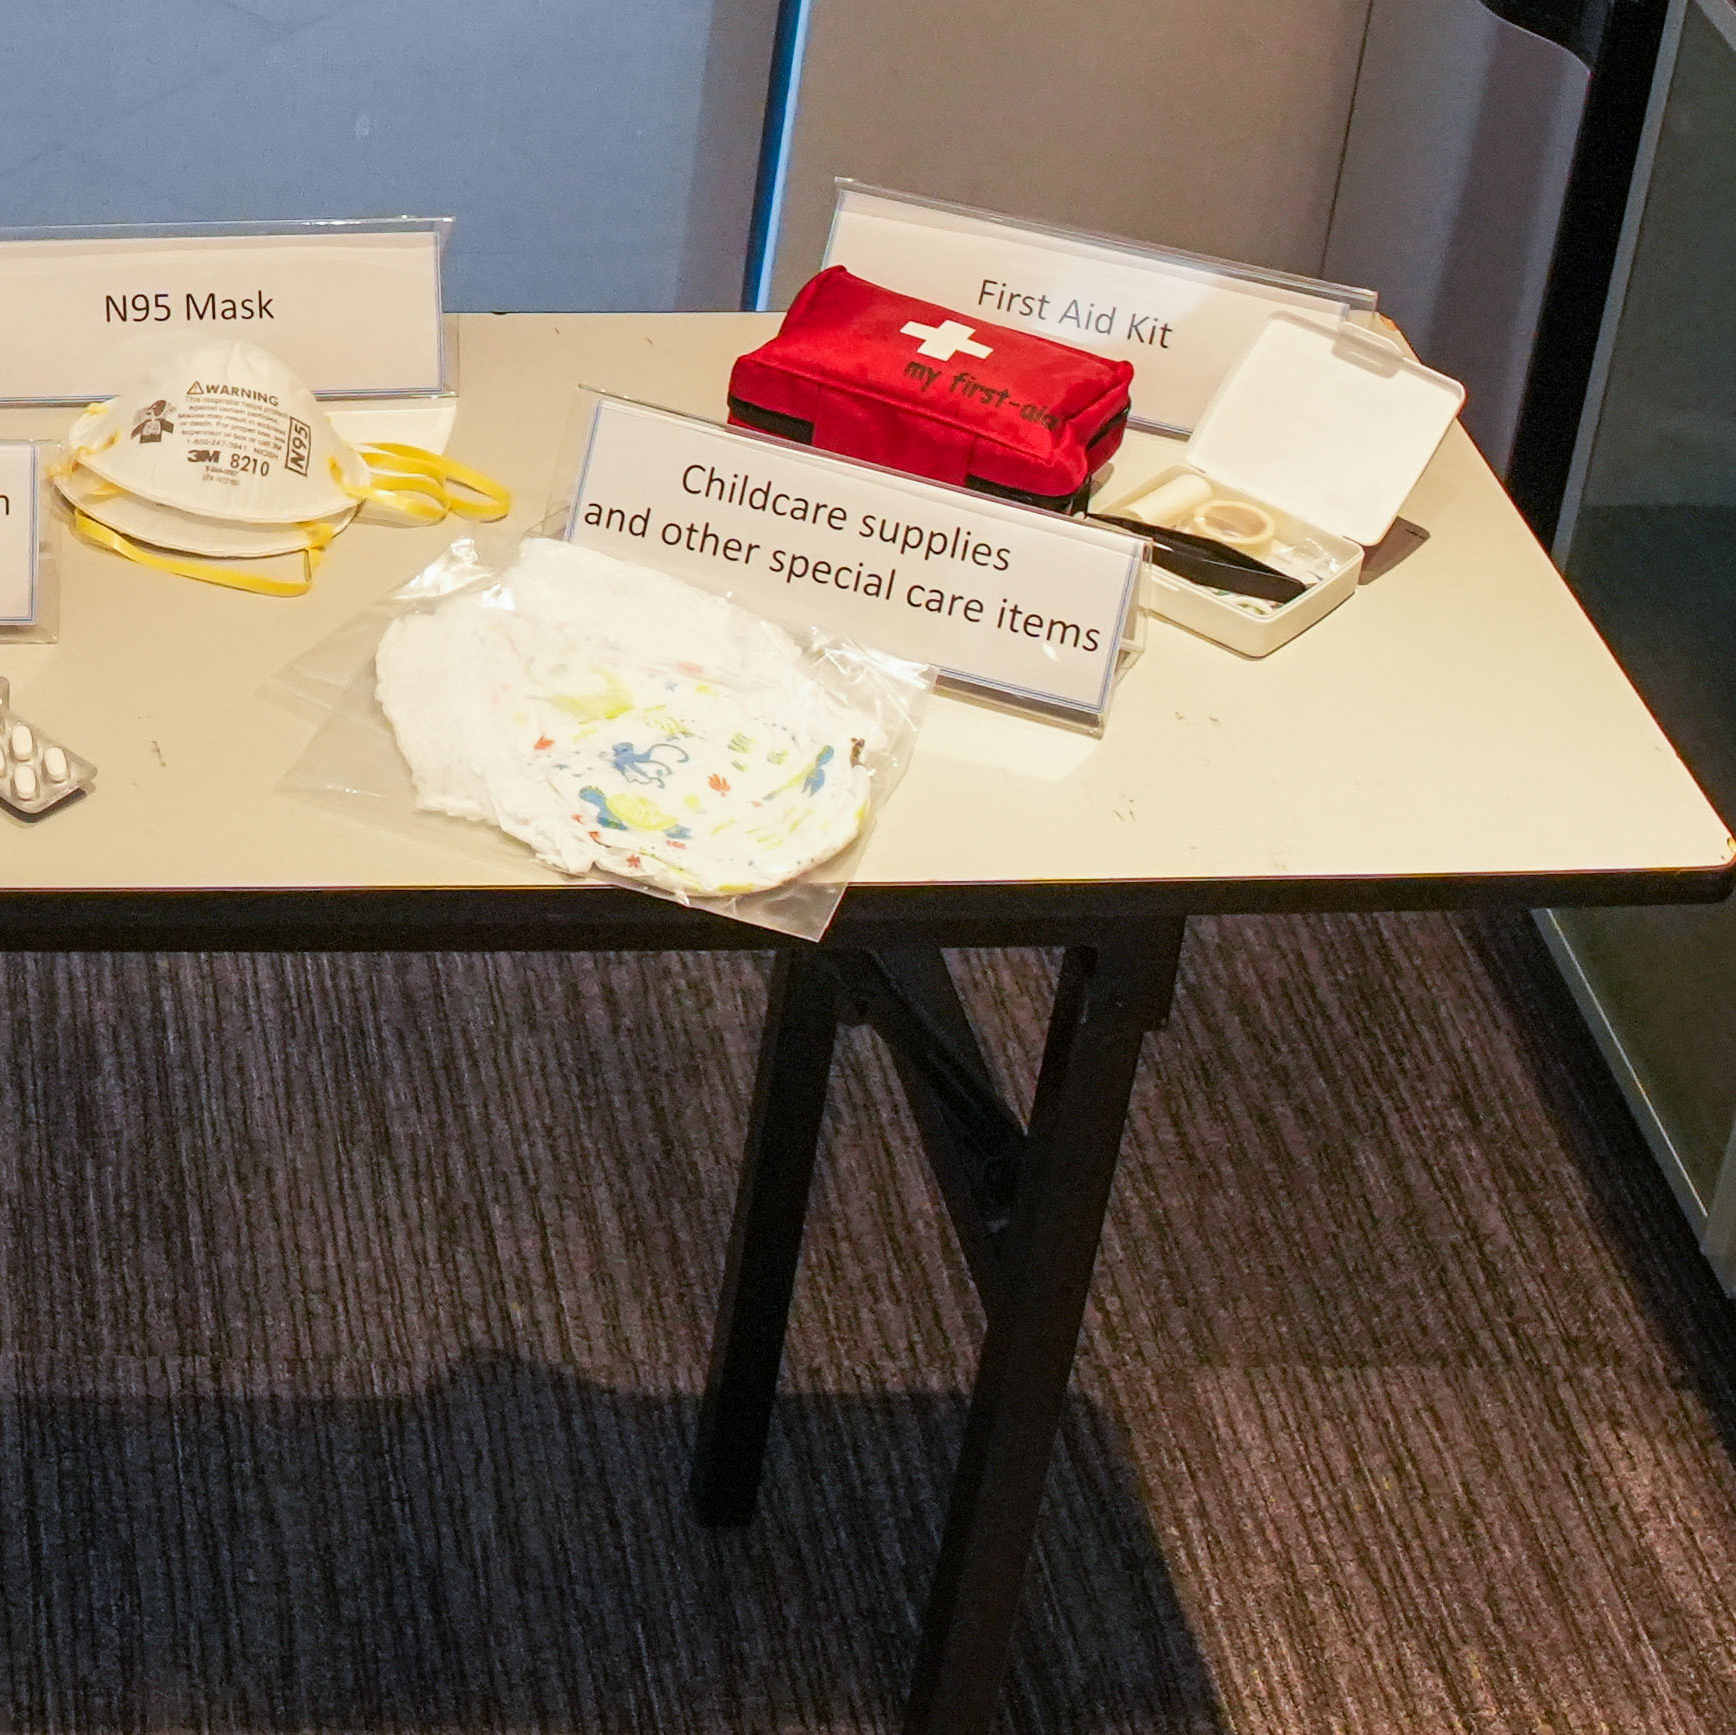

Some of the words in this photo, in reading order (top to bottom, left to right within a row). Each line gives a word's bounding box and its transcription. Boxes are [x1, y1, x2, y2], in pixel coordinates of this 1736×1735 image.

[105, 293, 171, 323] N95
[185, 289, 274, 321] Mask
[977, 279, 1050, 321] First
[1058, 299, 1117, 335] Aid
[1126, 313, 1174, 350] Kit
[206, 384, 279, 406] WARNING
[903, 361, 942, 392] my
[187, 449, 221, 463] 3M
[230, 453, 270, 477] 8210
[290, 423, 308, 470] N95
[682, 464, 847, 531] Childcare
[858, 514, 1011, 571] supplies
[584, 503, 652, 538] and
[661, 521, 761, 565] other
[768, 549, 896, 601] special
[906, 584, 984, 623] care
[997, 598, 1100, 652] items
